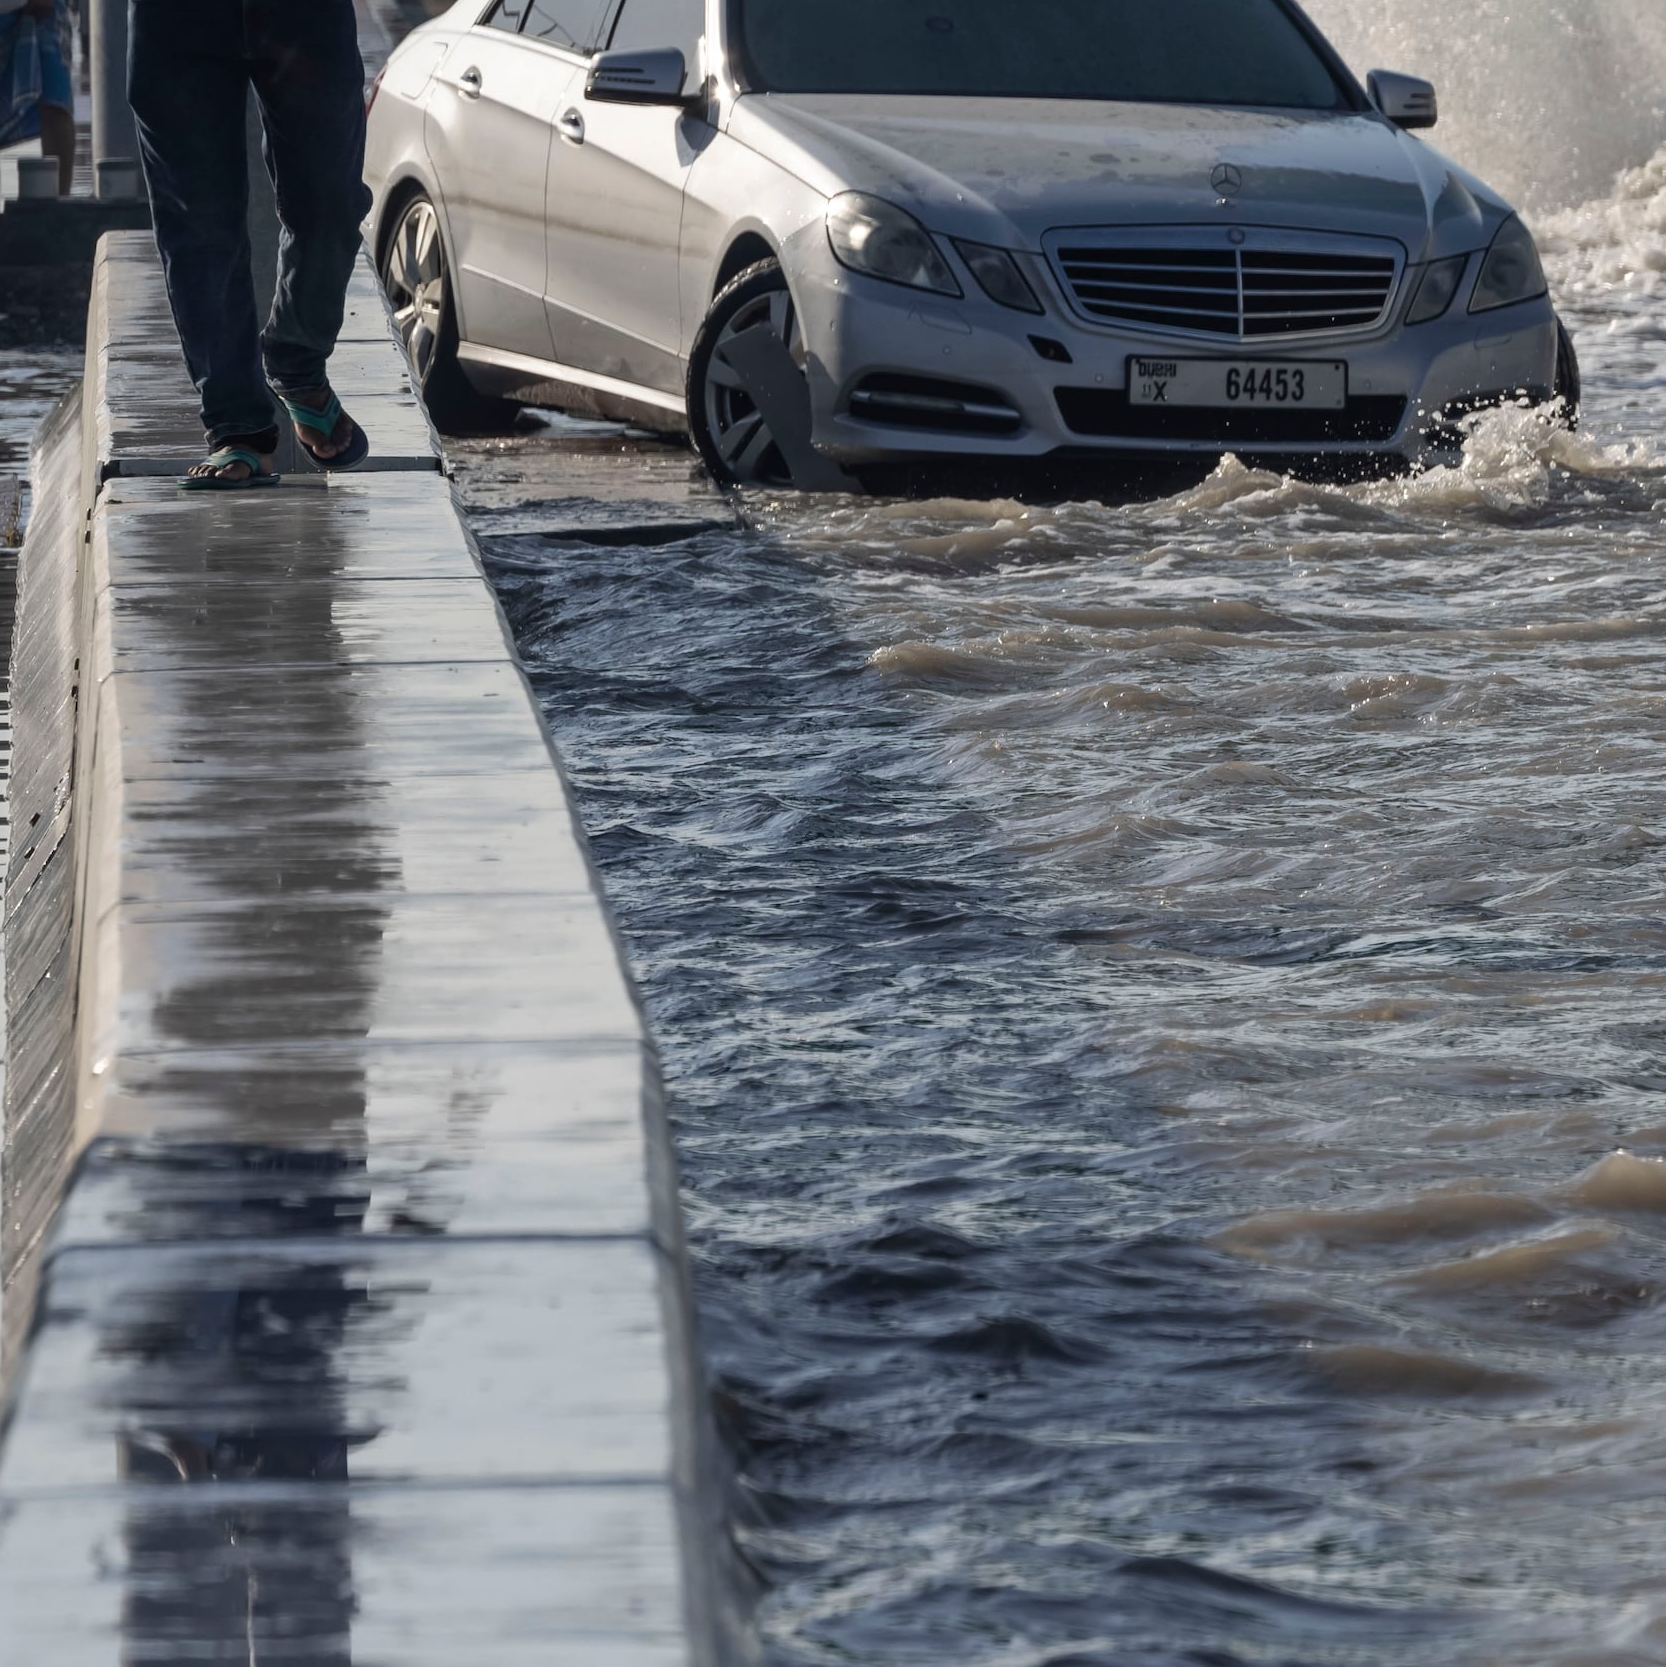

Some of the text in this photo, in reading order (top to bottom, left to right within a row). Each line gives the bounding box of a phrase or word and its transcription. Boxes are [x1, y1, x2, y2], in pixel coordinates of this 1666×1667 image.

[1138, 362, 1177, 378] DUBAI
[1153, 380, 1167, 402] X
[1225, 367, 1306, 402] 64453
